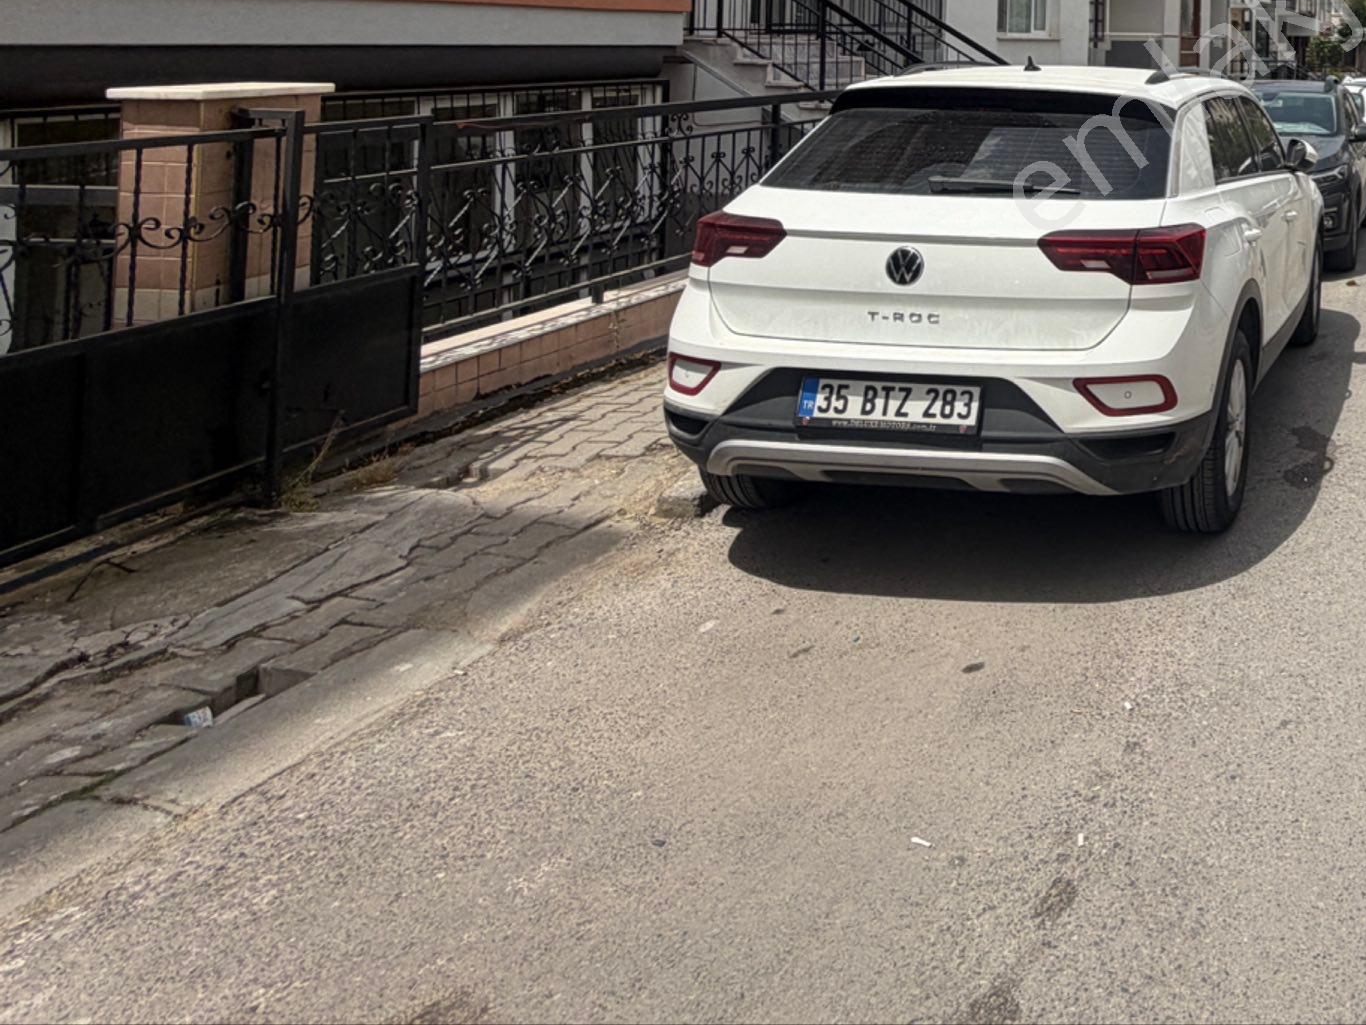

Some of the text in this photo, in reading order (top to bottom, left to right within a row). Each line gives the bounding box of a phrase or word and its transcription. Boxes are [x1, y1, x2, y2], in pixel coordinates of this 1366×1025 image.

[867, 311, 940, 324] T-ROC
[817, 384, 850, 414] 35
[860, 385, 913, 418] BTZ
[922, 388, 974, 420] 283
